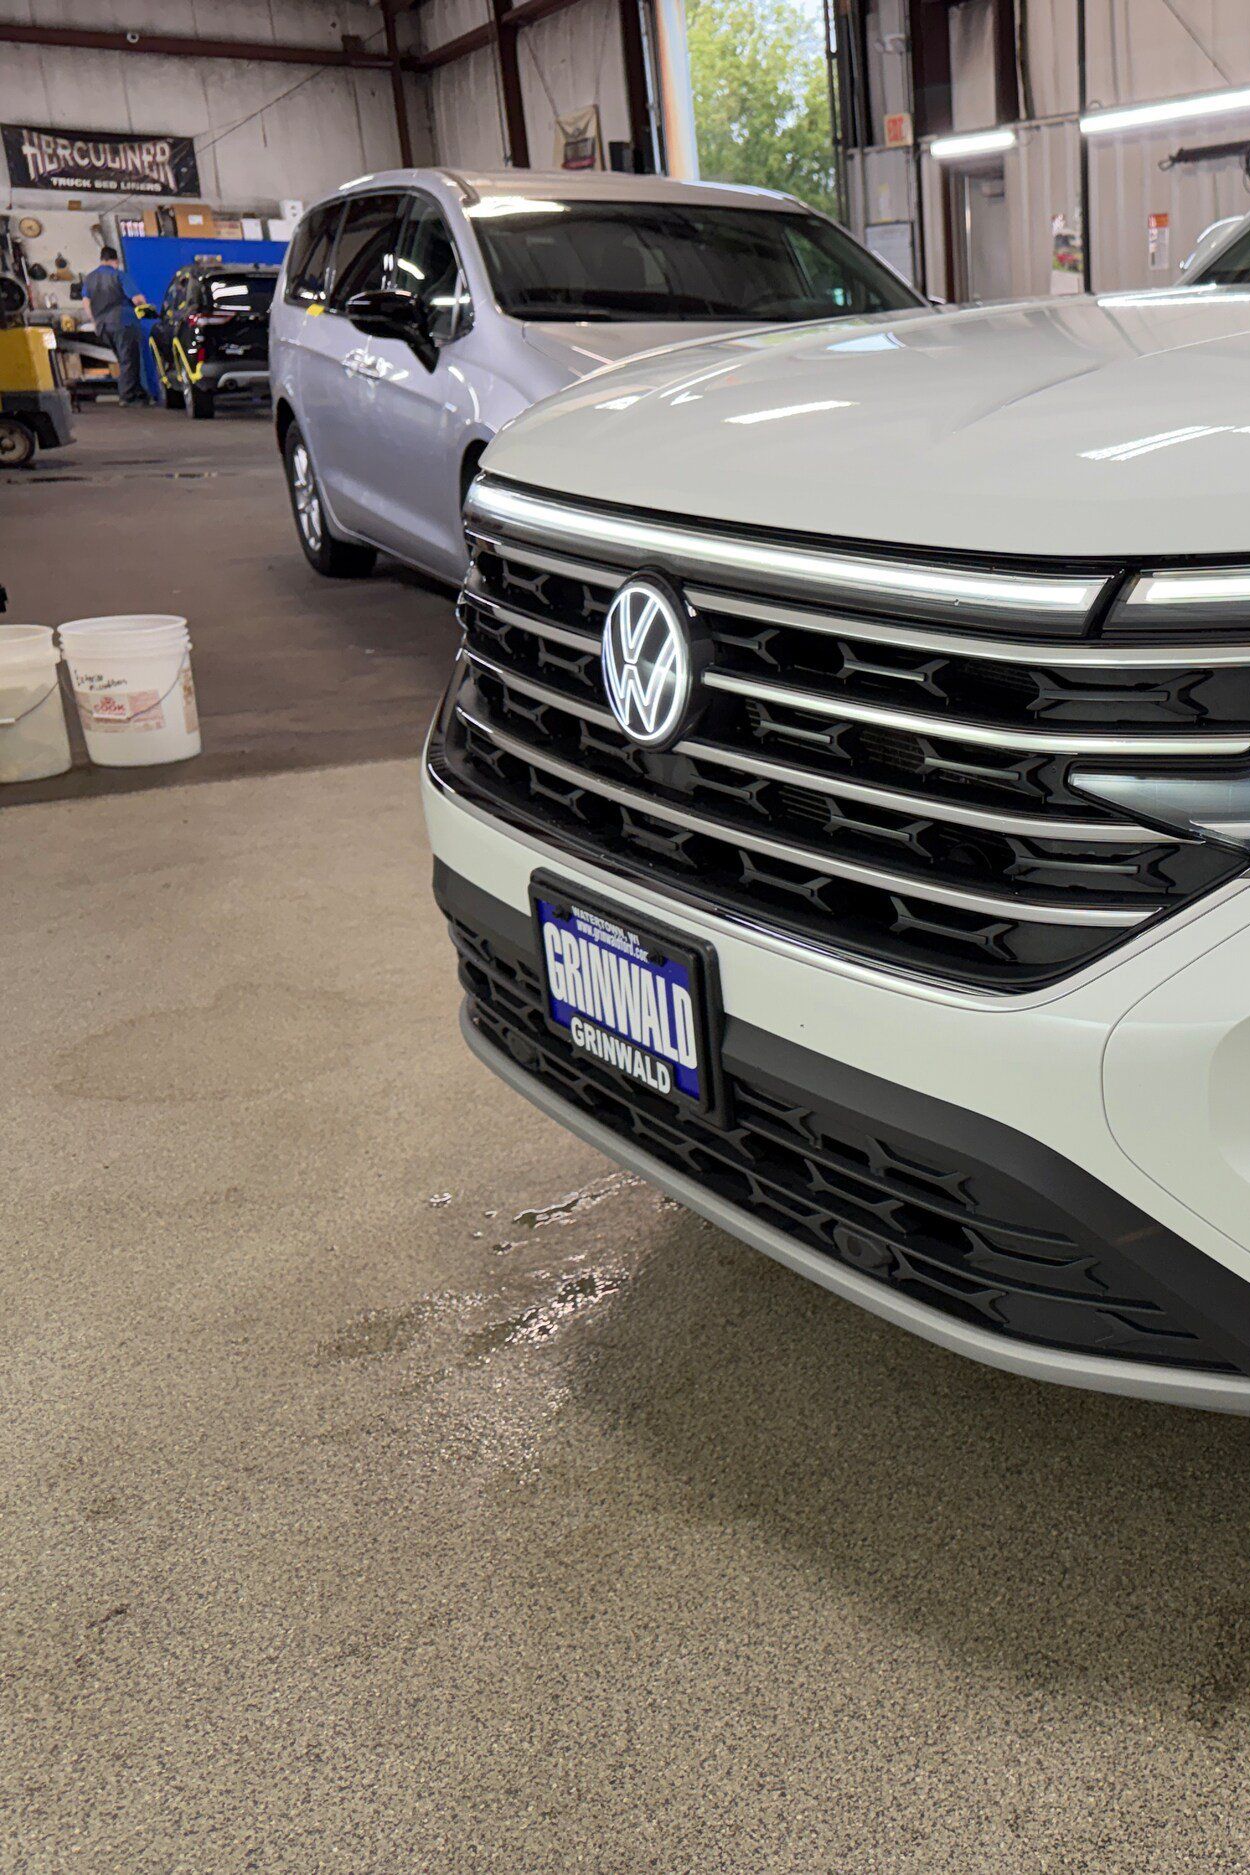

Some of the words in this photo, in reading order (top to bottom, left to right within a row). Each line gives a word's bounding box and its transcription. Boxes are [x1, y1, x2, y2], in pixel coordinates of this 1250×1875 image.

[22, 129, 177, 194] HERCULINER
[50, 176, 92, 189] TRUCK
[94, 179, 118, 190] BED
[120, 181, 162, 192] LINERS
[543, 921, 698, 1070] GRINWALD
[571, 1016, 671, 1094] GRINWALD
